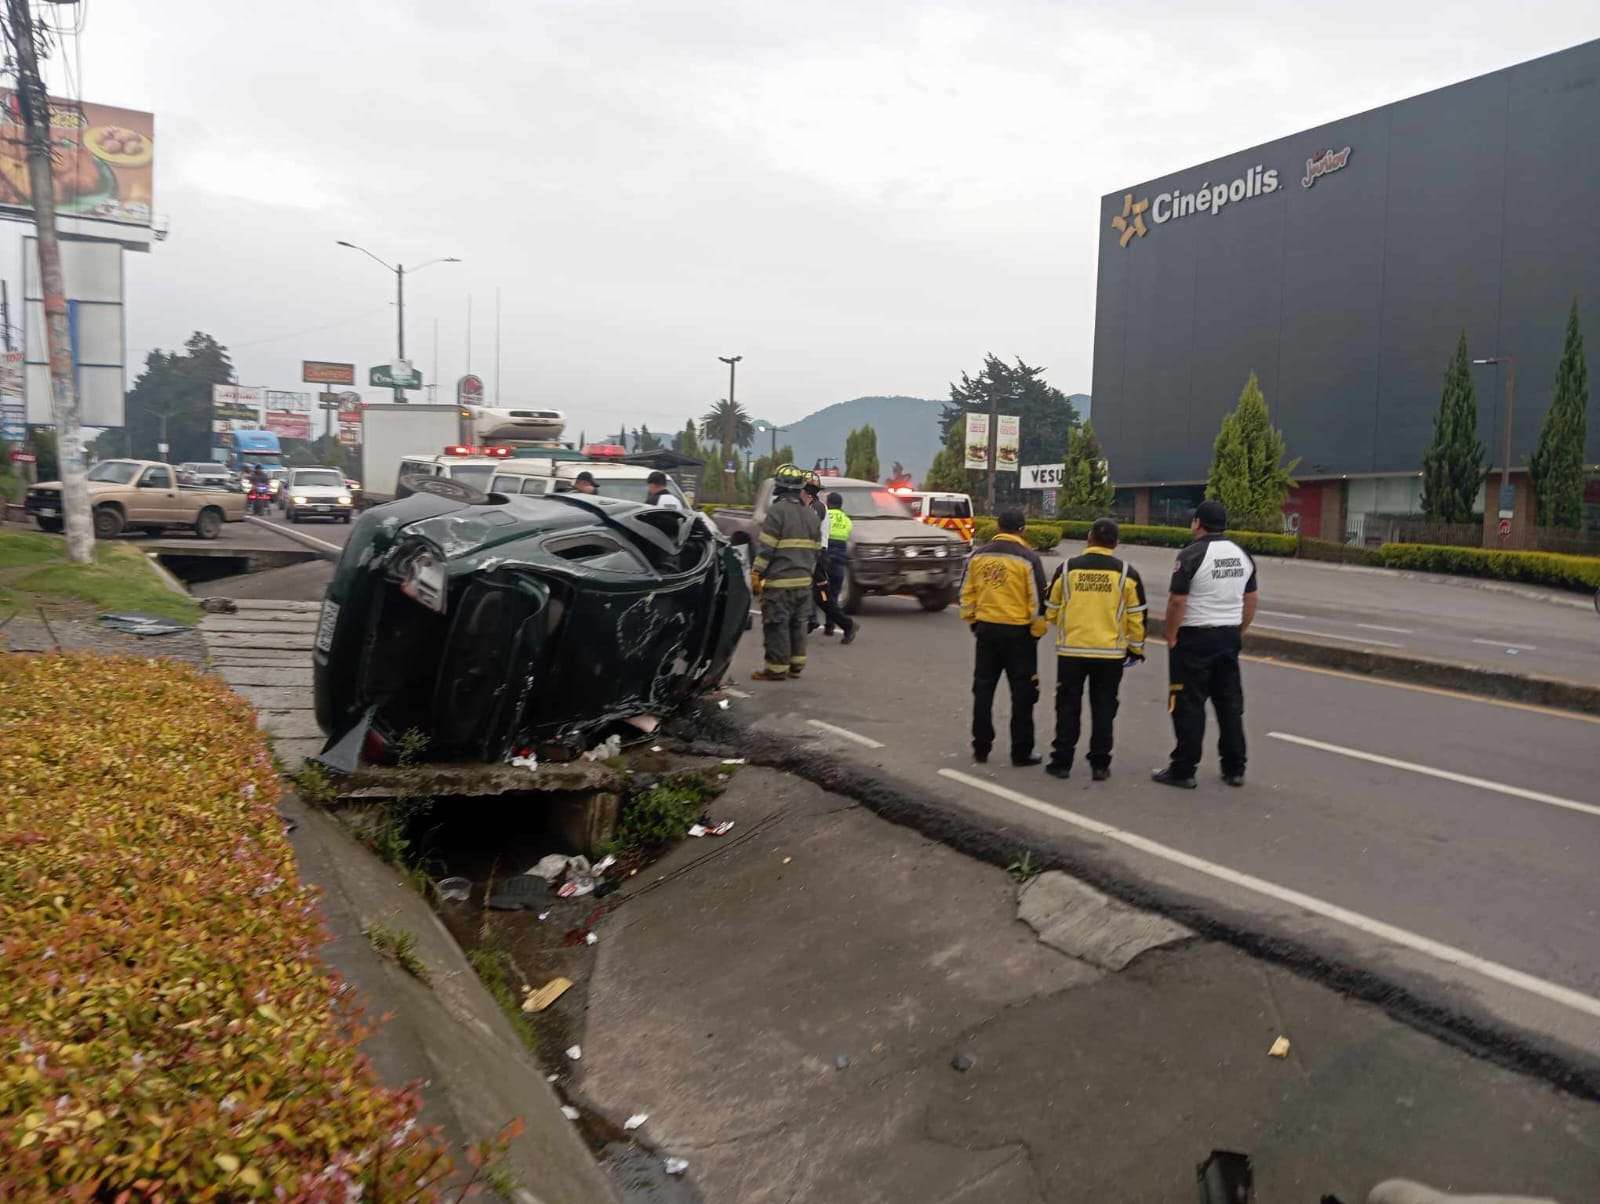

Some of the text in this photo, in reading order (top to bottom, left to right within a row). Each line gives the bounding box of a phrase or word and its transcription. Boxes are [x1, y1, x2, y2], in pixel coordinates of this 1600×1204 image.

[1152, 164, 1280, 224] Cinépolis
[1213, 558, 1242, 568] BOMBEROS
[1078, 572, 1110, 583] BOMBEROS
[1211, 568, 1245, 579] VOLUNTARIOS
[1074, 582, 1113, 592] VOLUNTARIOS
